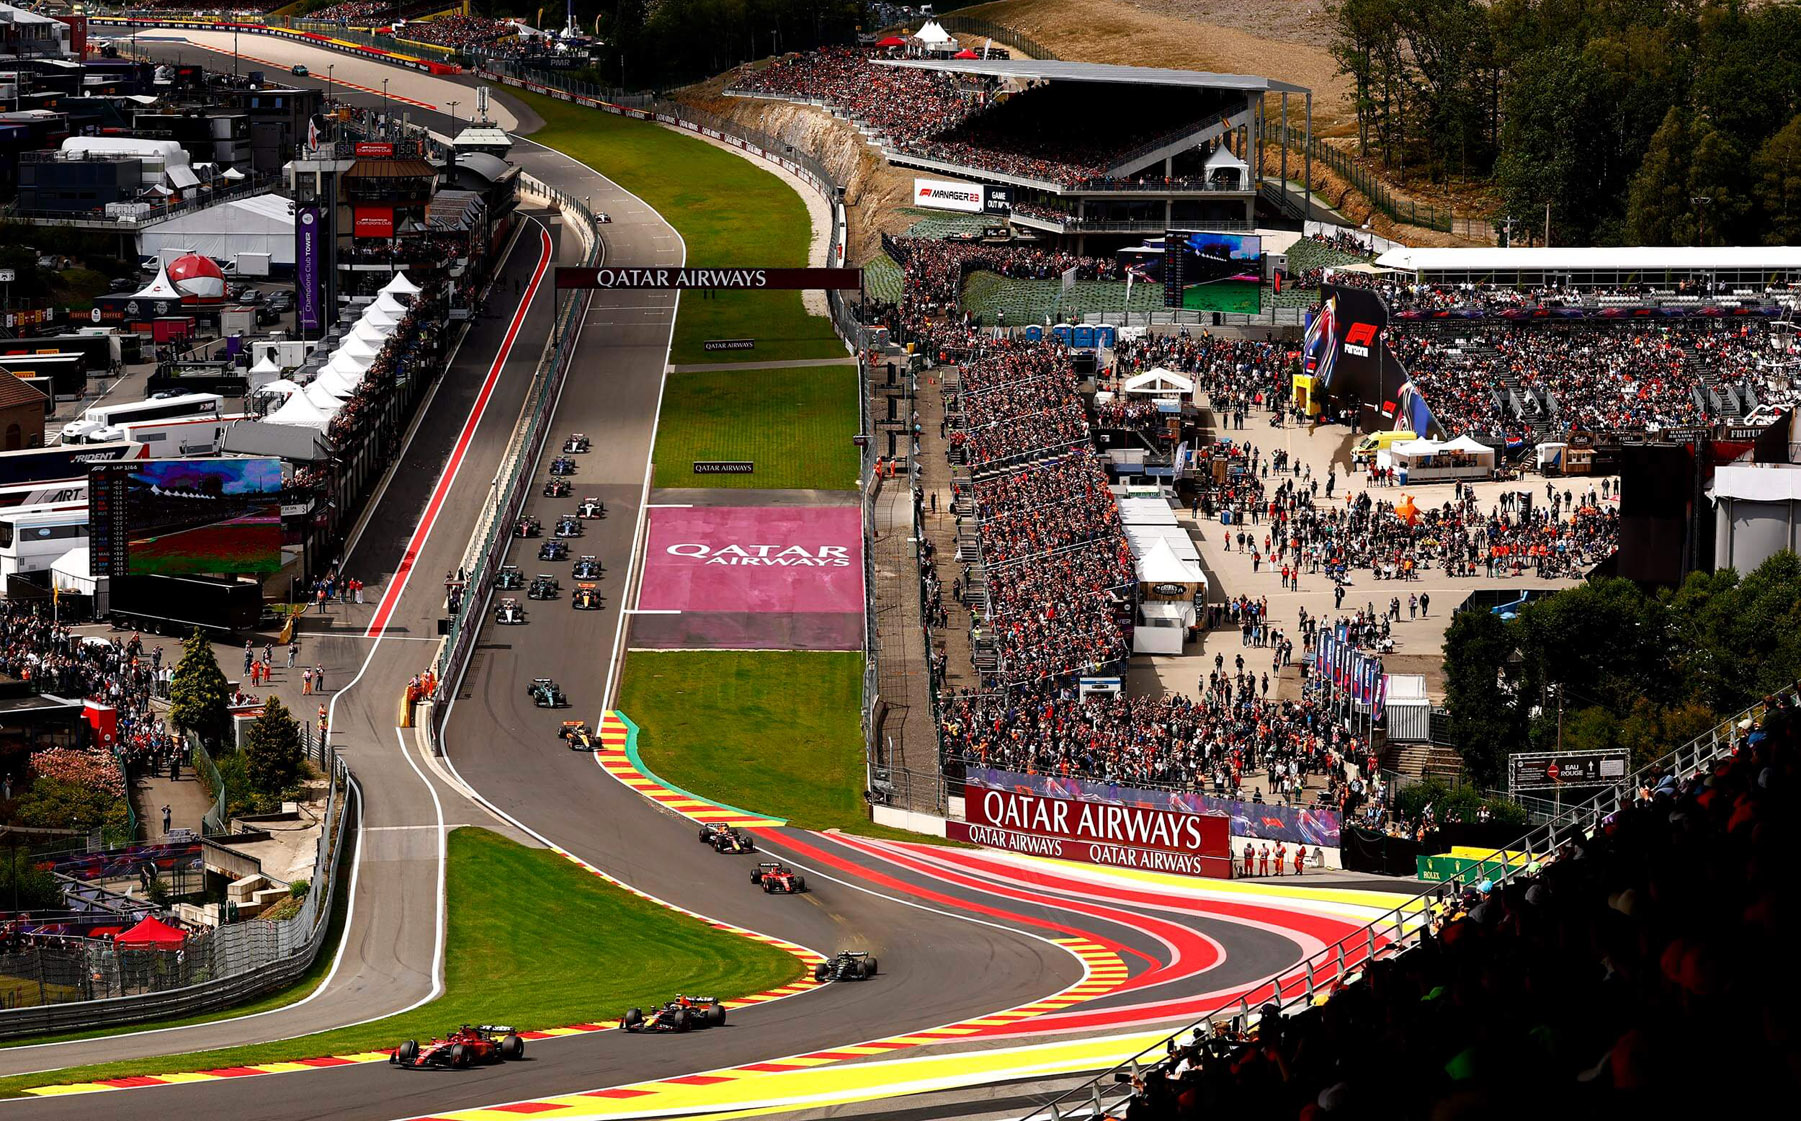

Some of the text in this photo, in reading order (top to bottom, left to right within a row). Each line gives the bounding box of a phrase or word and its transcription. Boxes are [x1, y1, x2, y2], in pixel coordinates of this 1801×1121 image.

[397, 144, 417, 154] 15:04
[932, 190, 969, 201] MANAGER
[970, 193, 979, 203] 23
[992, 191, 1006, 200] GAME
[988, 201, 998, 209] OUT
[597, 269, 766, 287] QATAR AIRWAYS
[705, 341, 753, 350] QATAR AIRWAYS
[695, 464, 752, 473] QATAR AIRWAYS
[49, 488, 83, 503] ART
[667, 543, 849, 558] QATAR
[705, 557, 850, 567] AIRWAYS
[984, 791, 1201, 850] QATAR AIRWAYS
[969, 825, 1062, 857] QATAR AIRWAYS
[1089, 844, 1201, 874] QATAR AIRWAYS
[1423, 870, 1440, 879] ROLEX
